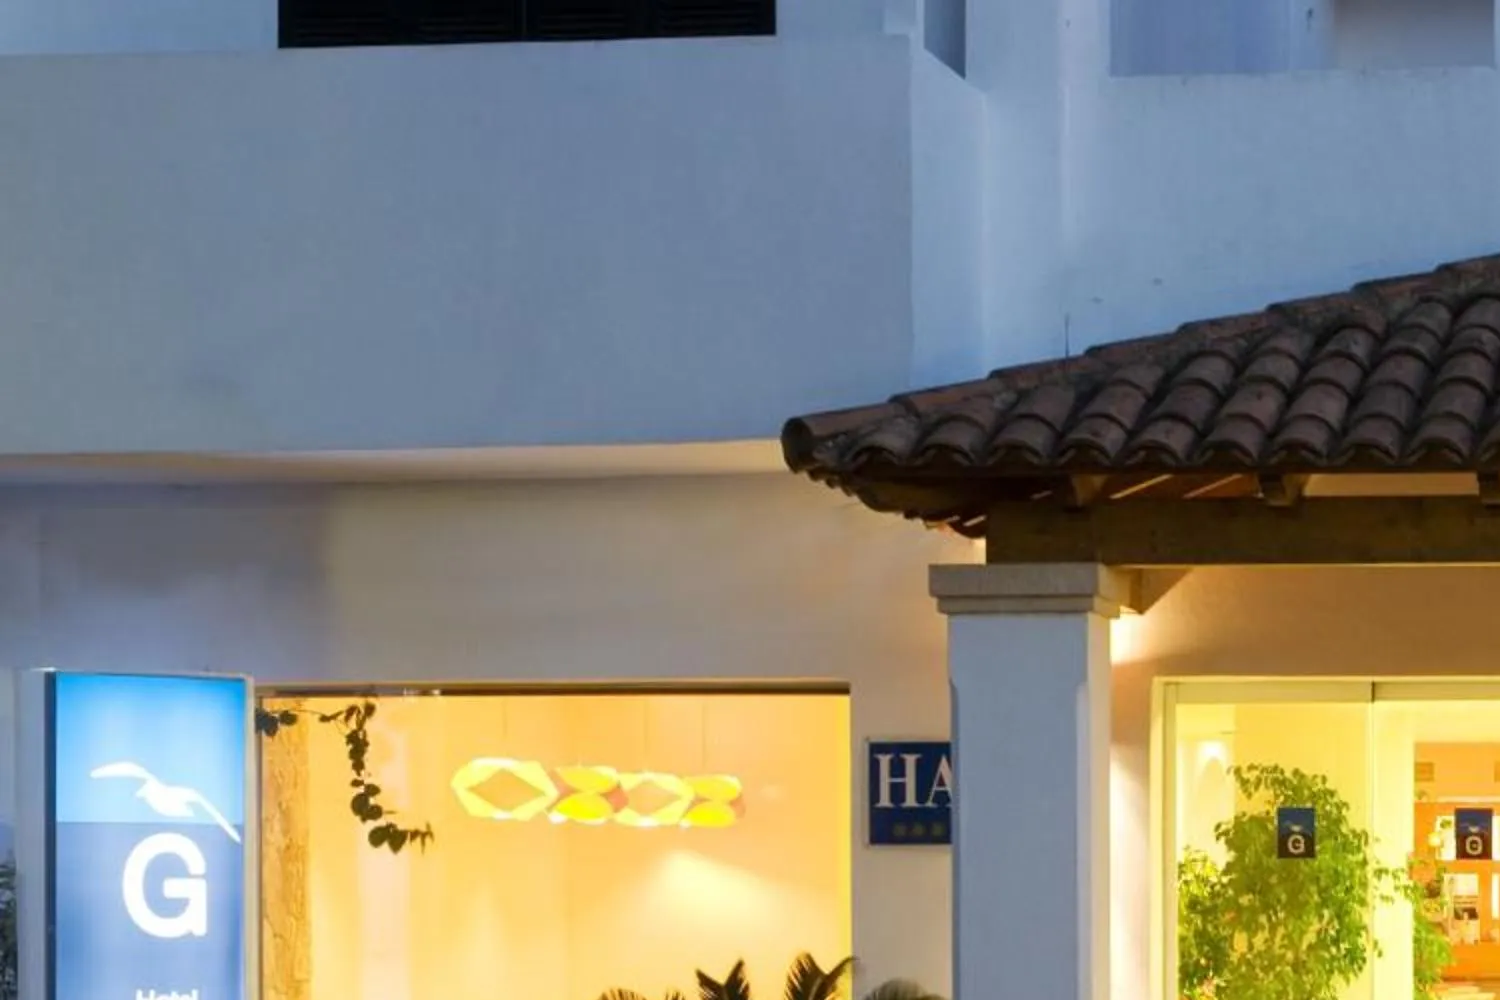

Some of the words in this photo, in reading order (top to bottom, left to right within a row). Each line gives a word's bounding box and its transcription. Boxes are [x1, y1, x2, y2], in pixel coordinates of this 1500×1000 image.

[1287, 833, 1306, 855] G
[1465, 835, 1483, 856] G
[122, 831, 208, 938] G
